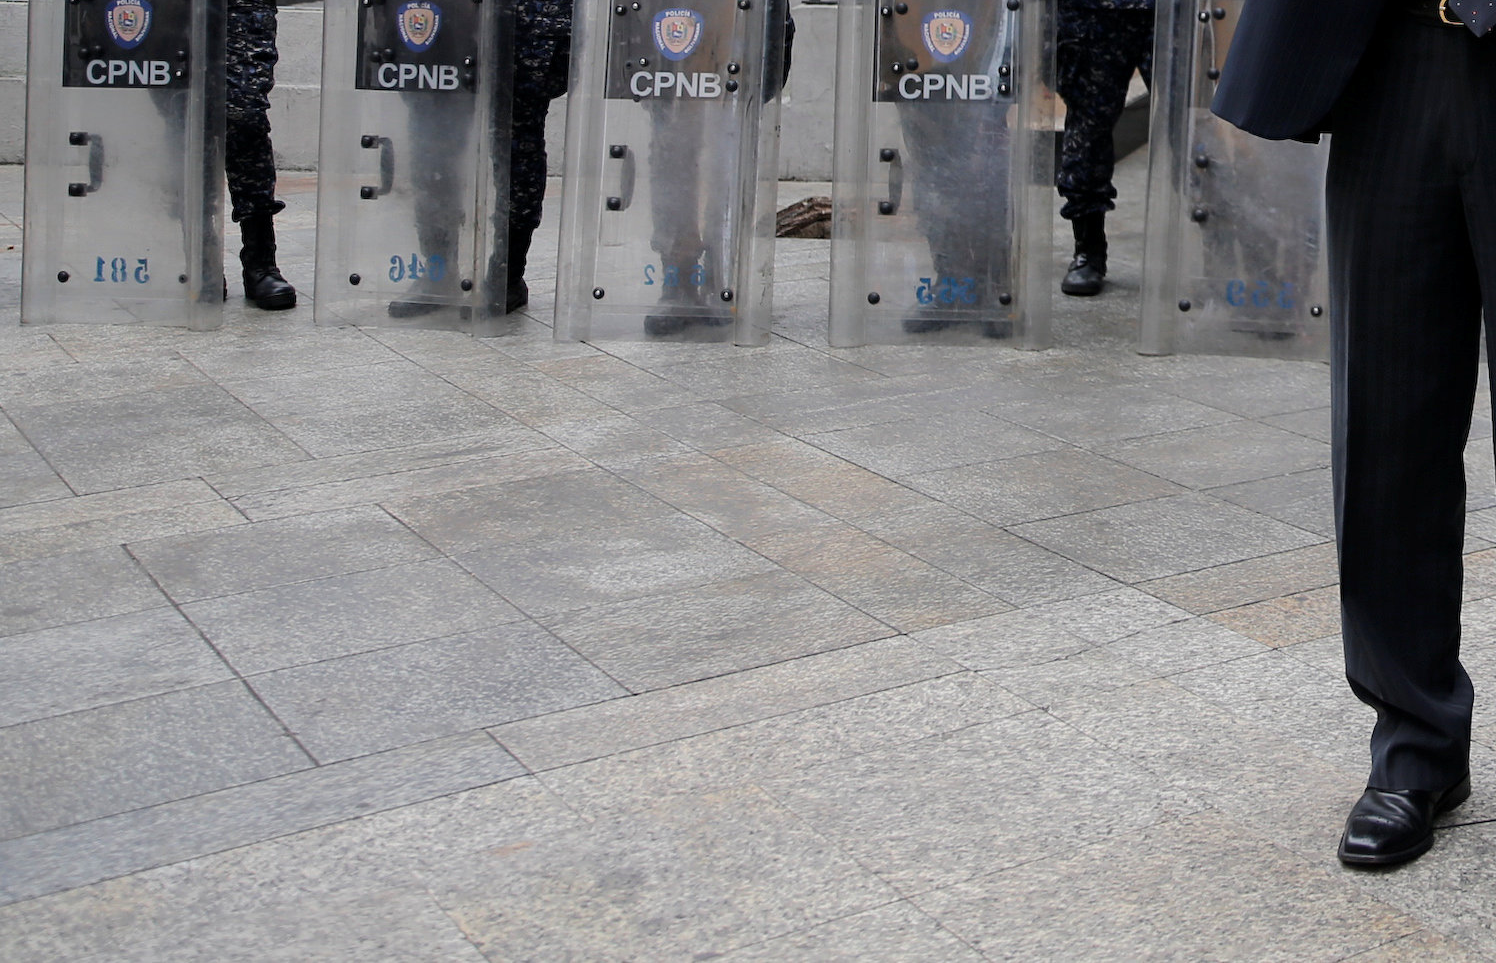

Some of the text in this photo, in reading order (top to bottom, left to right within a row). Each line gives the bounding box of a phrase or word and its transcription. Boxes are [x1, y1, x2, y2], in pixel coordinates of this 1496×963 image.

[933, 10, 960, 19] POLICÍA
[86, 59, 171, 85] CPNB
[377, 62, 459, 90] CPNB
[630, 70, 722, 98] CPNB
[898, 73, 992, 100] CPNB
